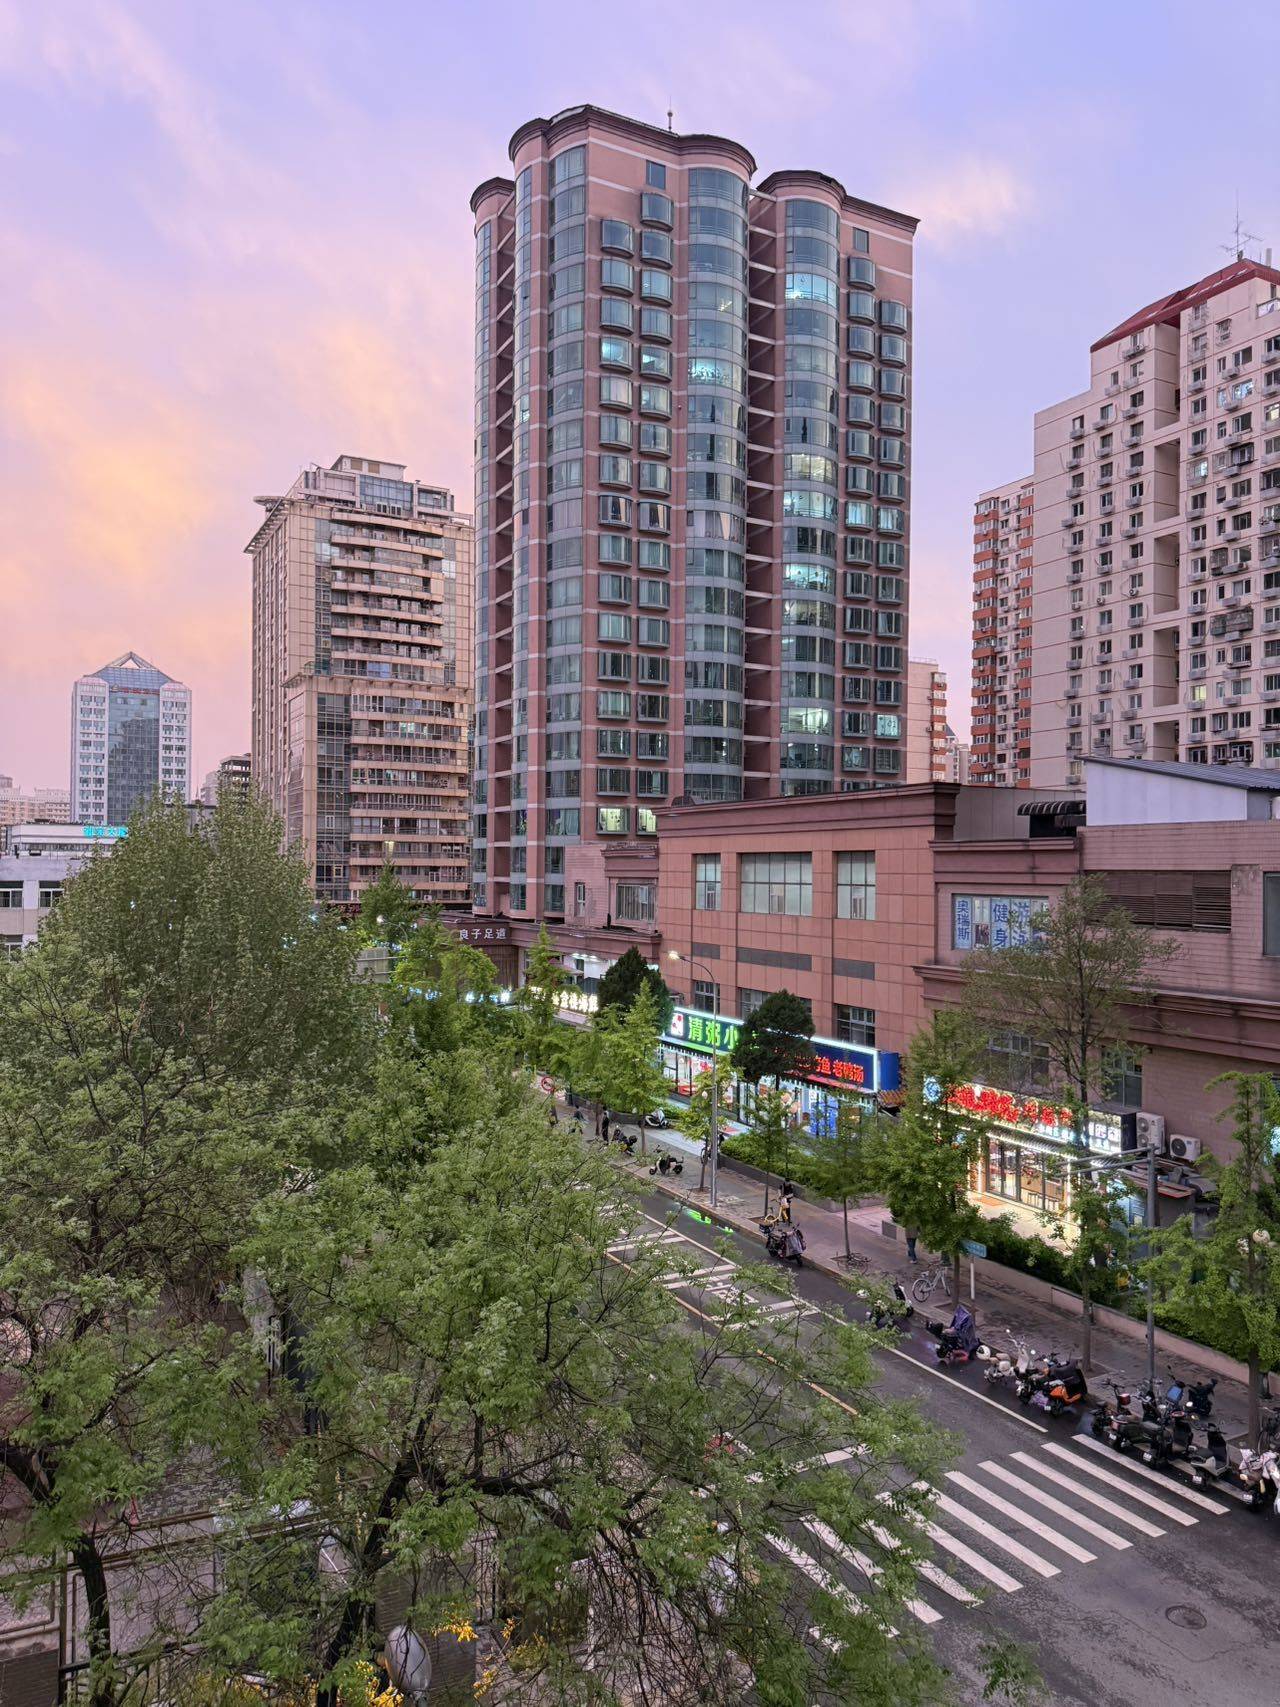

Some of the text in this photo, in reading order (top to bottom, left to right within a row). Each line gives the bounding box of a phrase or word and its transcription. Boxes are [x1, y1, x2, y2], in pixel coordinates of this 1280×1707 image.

[459, 928, 506, 939] 良子足道
[993, 904, 1008, 948] 健身
[688, 1016, 760, 1050] 清粥小
